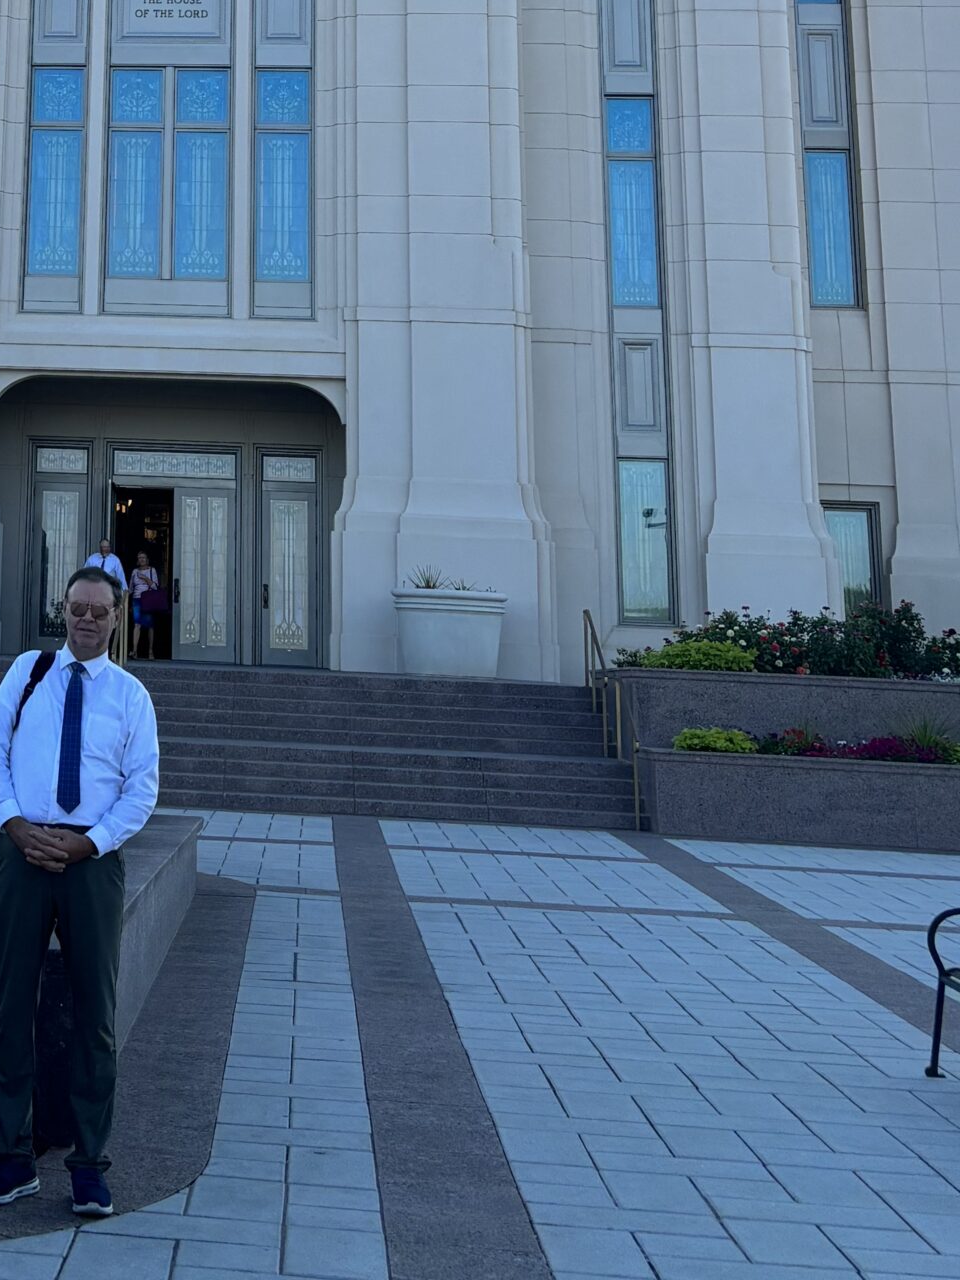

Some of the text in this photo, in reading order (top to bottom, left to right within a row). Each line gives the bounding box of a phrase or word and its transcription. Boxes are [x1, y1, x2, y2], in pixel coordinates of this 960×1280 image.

[135, 9, 208, 18] OF THE LORD
